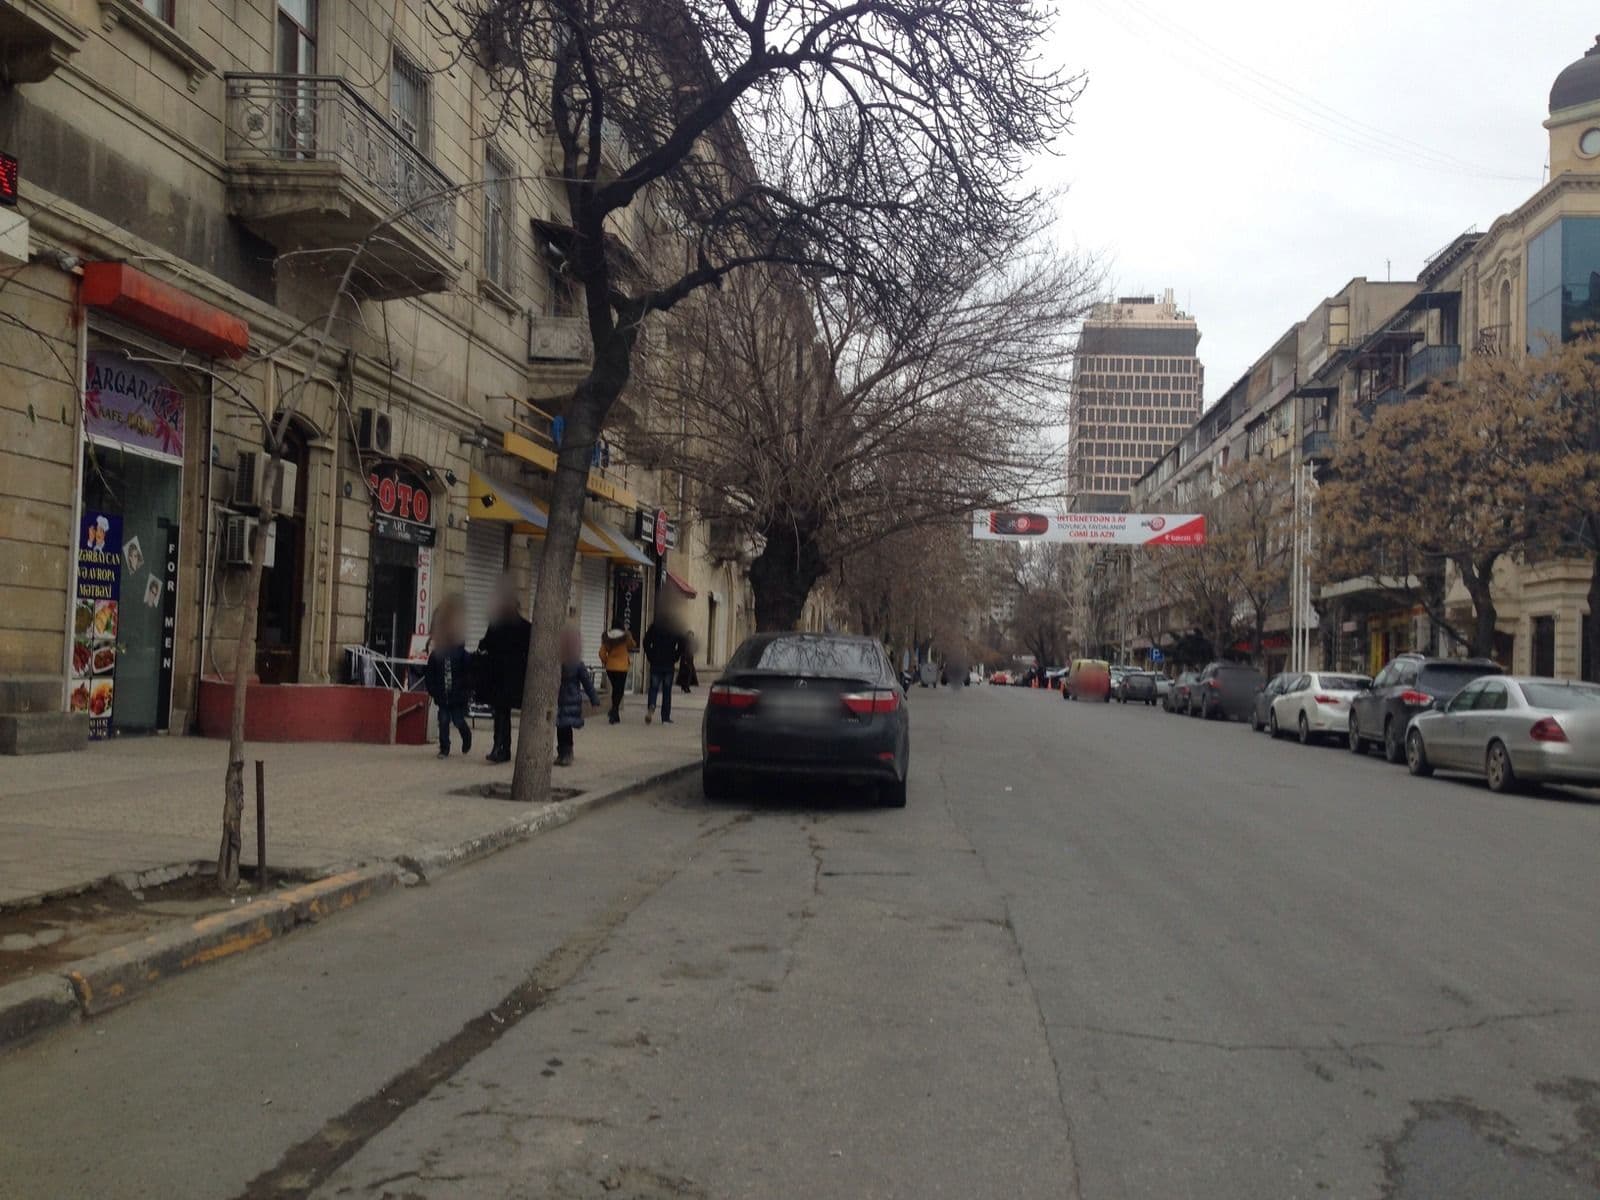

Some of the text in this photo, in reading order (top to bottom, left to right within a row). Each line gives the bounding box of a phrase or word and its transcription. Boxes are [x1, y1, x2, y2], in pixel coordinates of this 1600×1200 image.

[167, 544, 175, 591] FOR
[419, 573, 427, 635] FOTO
[163, 616, 173, 668] MEN
